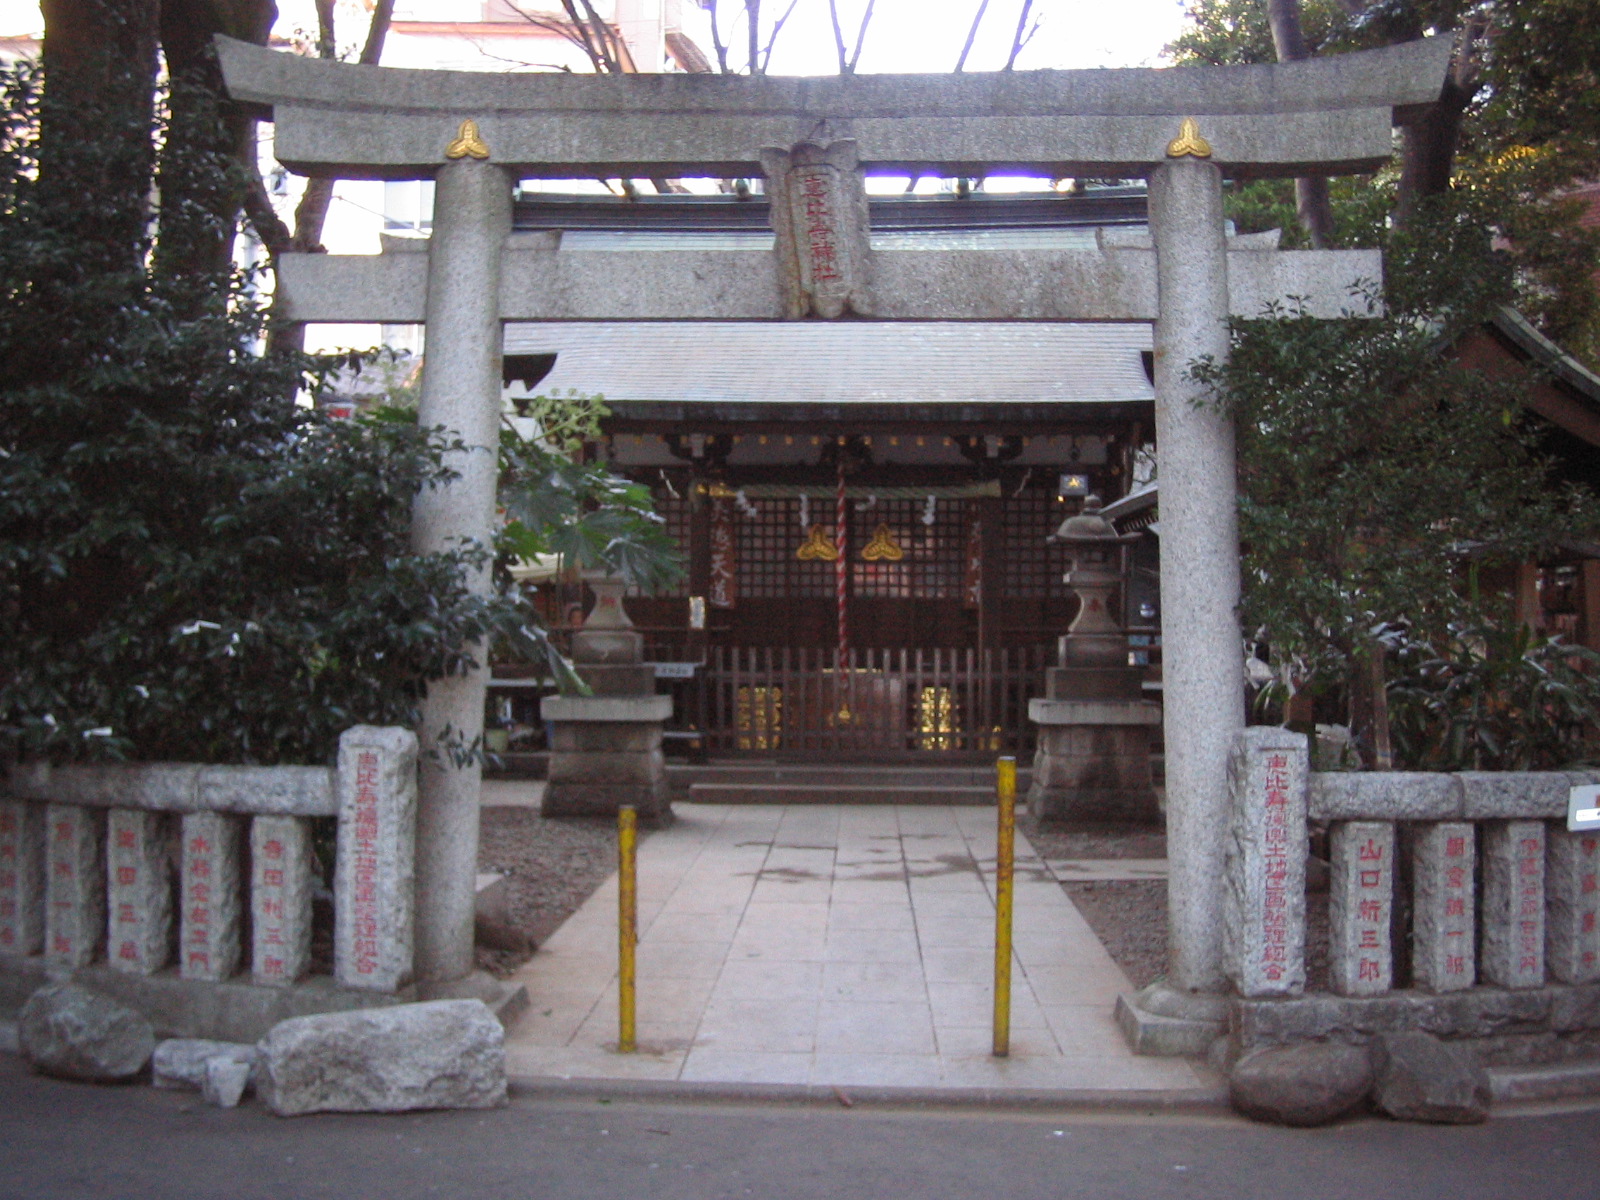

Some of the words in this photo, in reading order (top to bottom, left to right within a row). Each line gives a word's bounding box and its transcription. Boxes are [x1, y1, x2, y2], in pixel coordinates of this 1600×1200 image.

[1358, 837, 1383, 982] 山口新三郎
